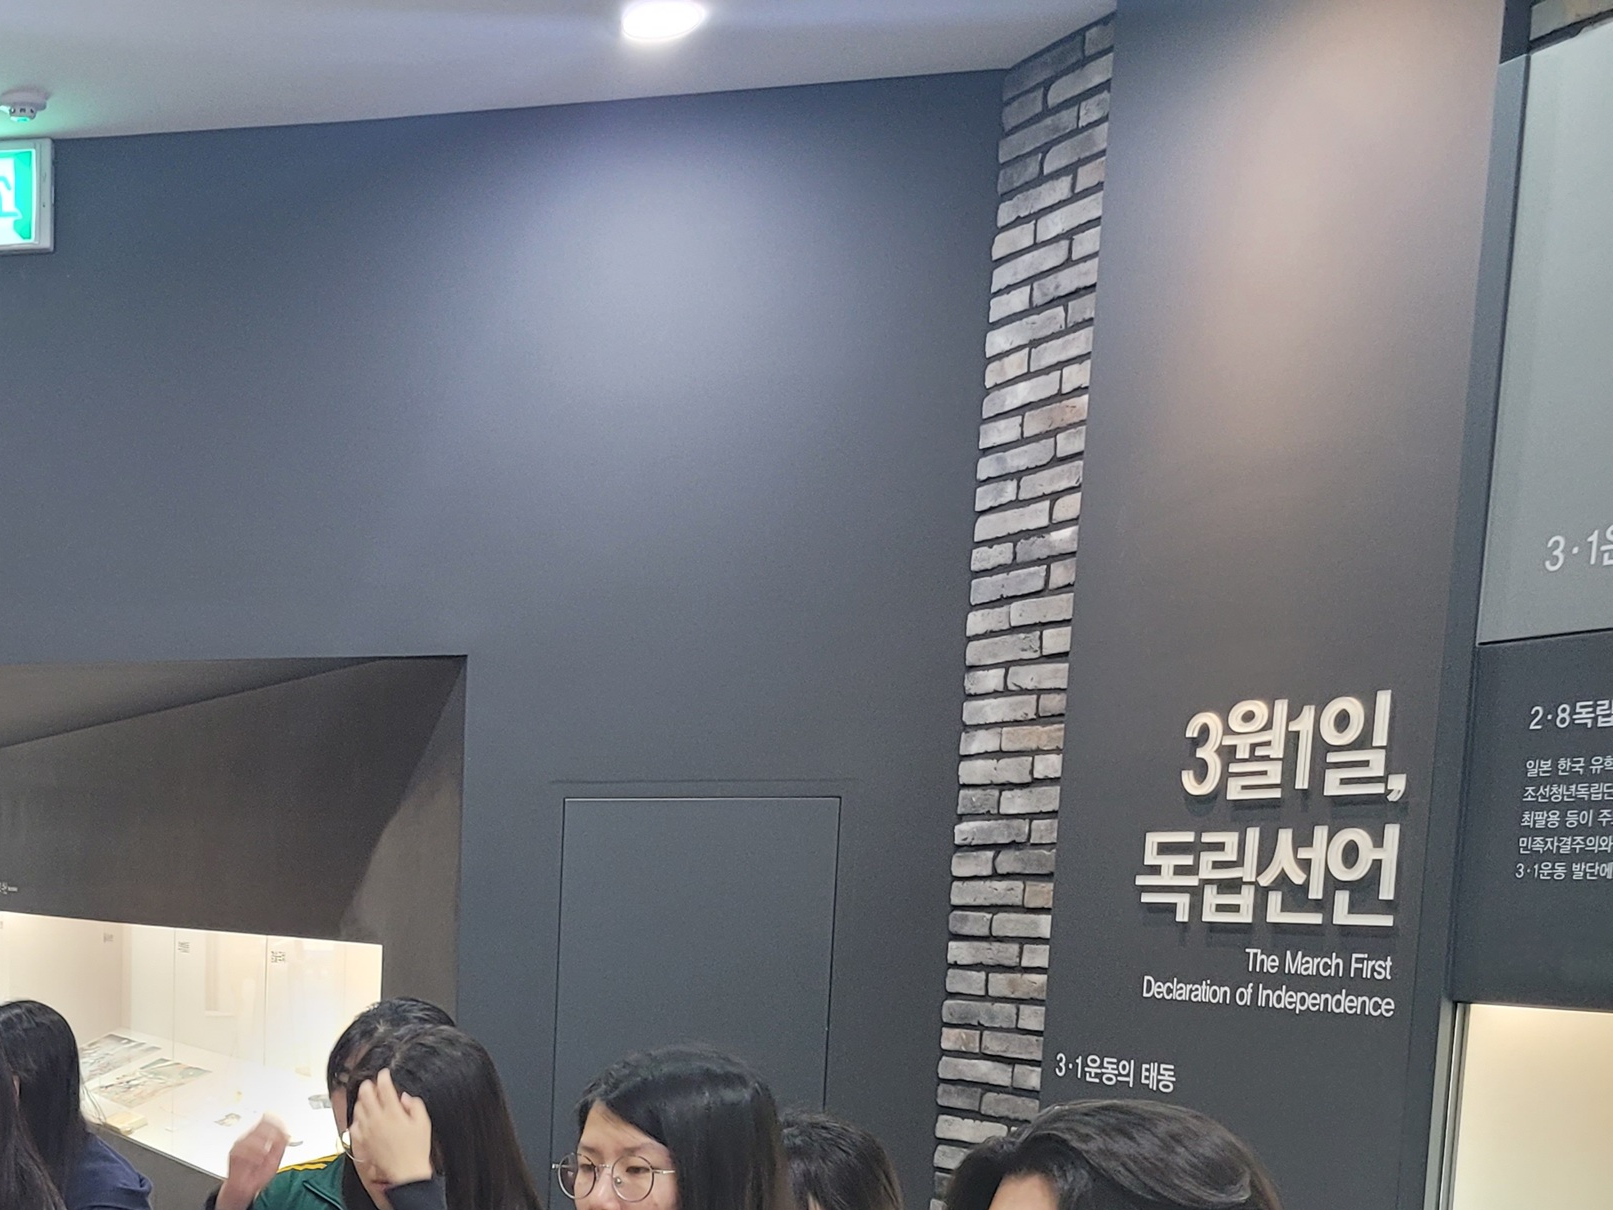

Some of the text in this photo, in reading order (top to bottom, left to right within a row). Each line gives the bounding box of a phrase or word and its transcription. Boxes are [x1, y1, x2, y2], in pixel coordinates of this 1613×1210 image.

[1181, 689, 1407, 801] 3월1일,
[1526, 758, 1552, 777] 일본
[1557, 757, 1585, 775] 한국
[1520, 810, 1560, 828] 최팔용
[1565, 809, 1593, 828] 등이
[1518, 835, 1613, 854] 민족자결주의와
[1135, 823, 1401, 926] 독립선언
[1515, 862, 1567, 880] 3·1운동
[1245, 948, 1393, 980] The March First
[1142, 975, 1395, 1017] Declaration of Independence
[1055, 1052, 1176, 1093] 3·1운동의 태동
